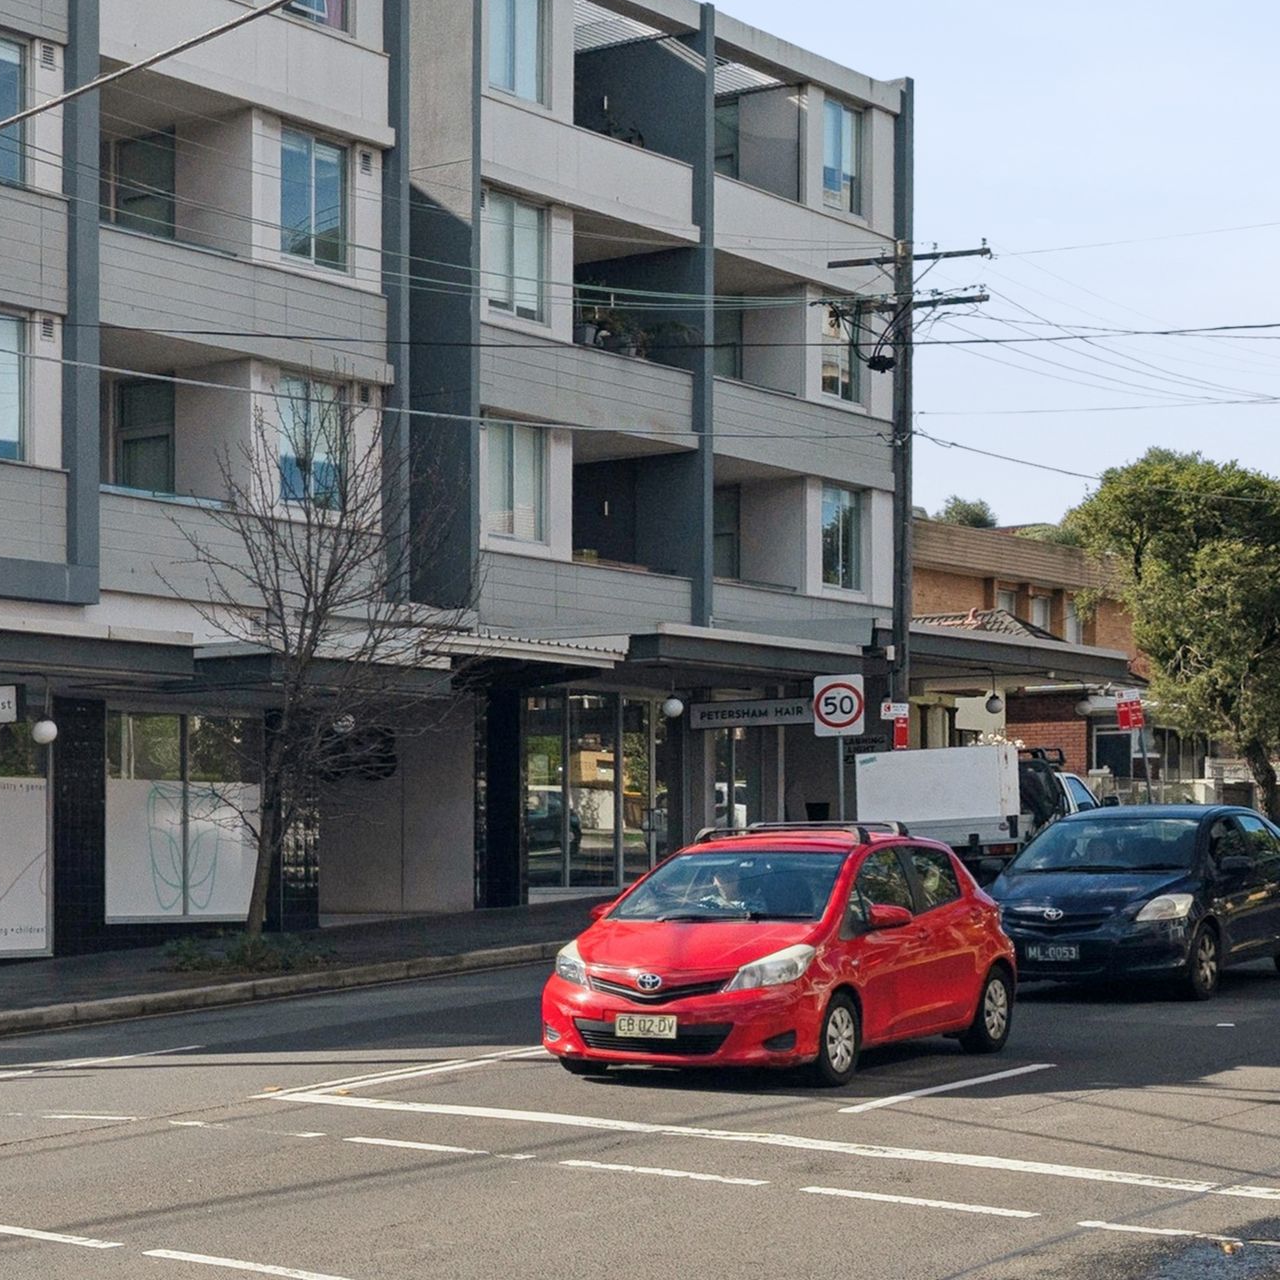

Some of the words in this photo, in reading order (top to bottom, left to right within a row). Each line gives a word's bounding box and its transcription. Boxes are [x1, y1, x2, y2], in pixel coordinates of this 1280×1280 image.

[700, 708, 769, 720] PETERSHAM
[774, 706, 804, 717] HAIR
[824, 695, 854, 716] 50
